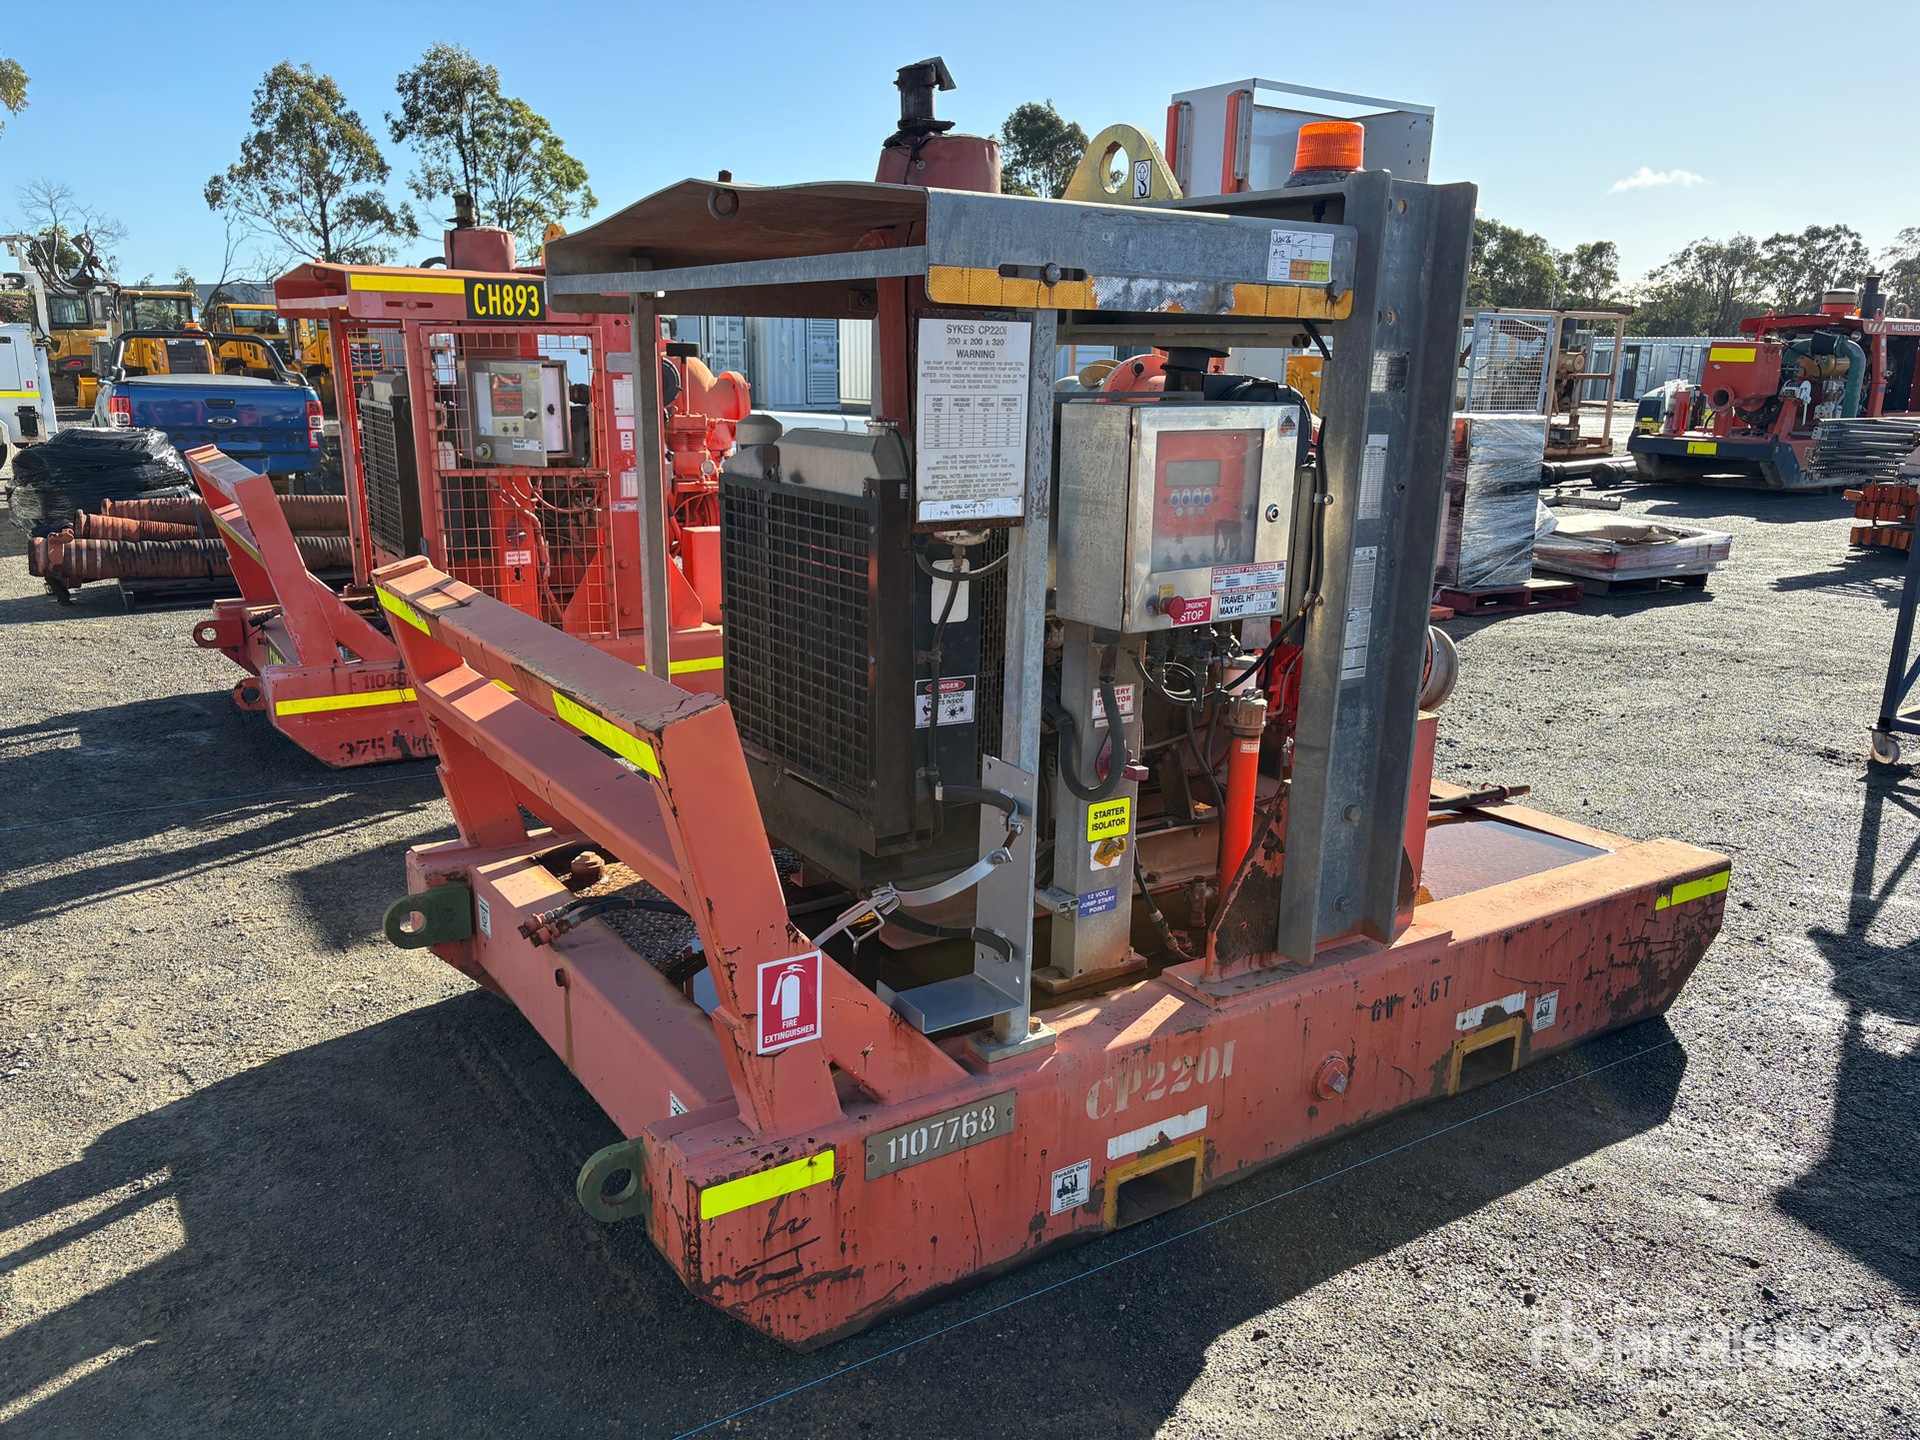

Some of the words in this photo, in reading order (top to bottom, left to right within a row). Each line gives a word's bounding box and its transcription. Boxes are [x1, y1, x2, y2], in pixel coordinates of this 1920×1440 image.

[474, 282, 540, 317] CH893
[946, 324, 974, 334] SYKES
[978, 325, 1007, 335] CP220i
[956, 349, 995, 358] WARNING
[171, 433, 303, 443] ANGER
[1185, 601, 1208, 609] ERGENCY
[1221, 595, 1245, 604] TRAVEL
[1180, 610, 1204, 622] STOP
[1220, 606, 1234, 615] MAX
[1094, 807, 1124, 819] STARTER
[1092, 818, 1125, 831] ISOLATOR
[1080, 900, 1096, 908] JUMP
[1098, 895, 1115, 904] START
[1089, 905, 1106, 913] POINT
[782, 1018, 798, 1029] FIRE
[764, 1024, 815, 1044] EXTINGUISHER
[887, 1105, 996, 1164] 1107768
[1055, 1169, 1075, 1180] Forklift
